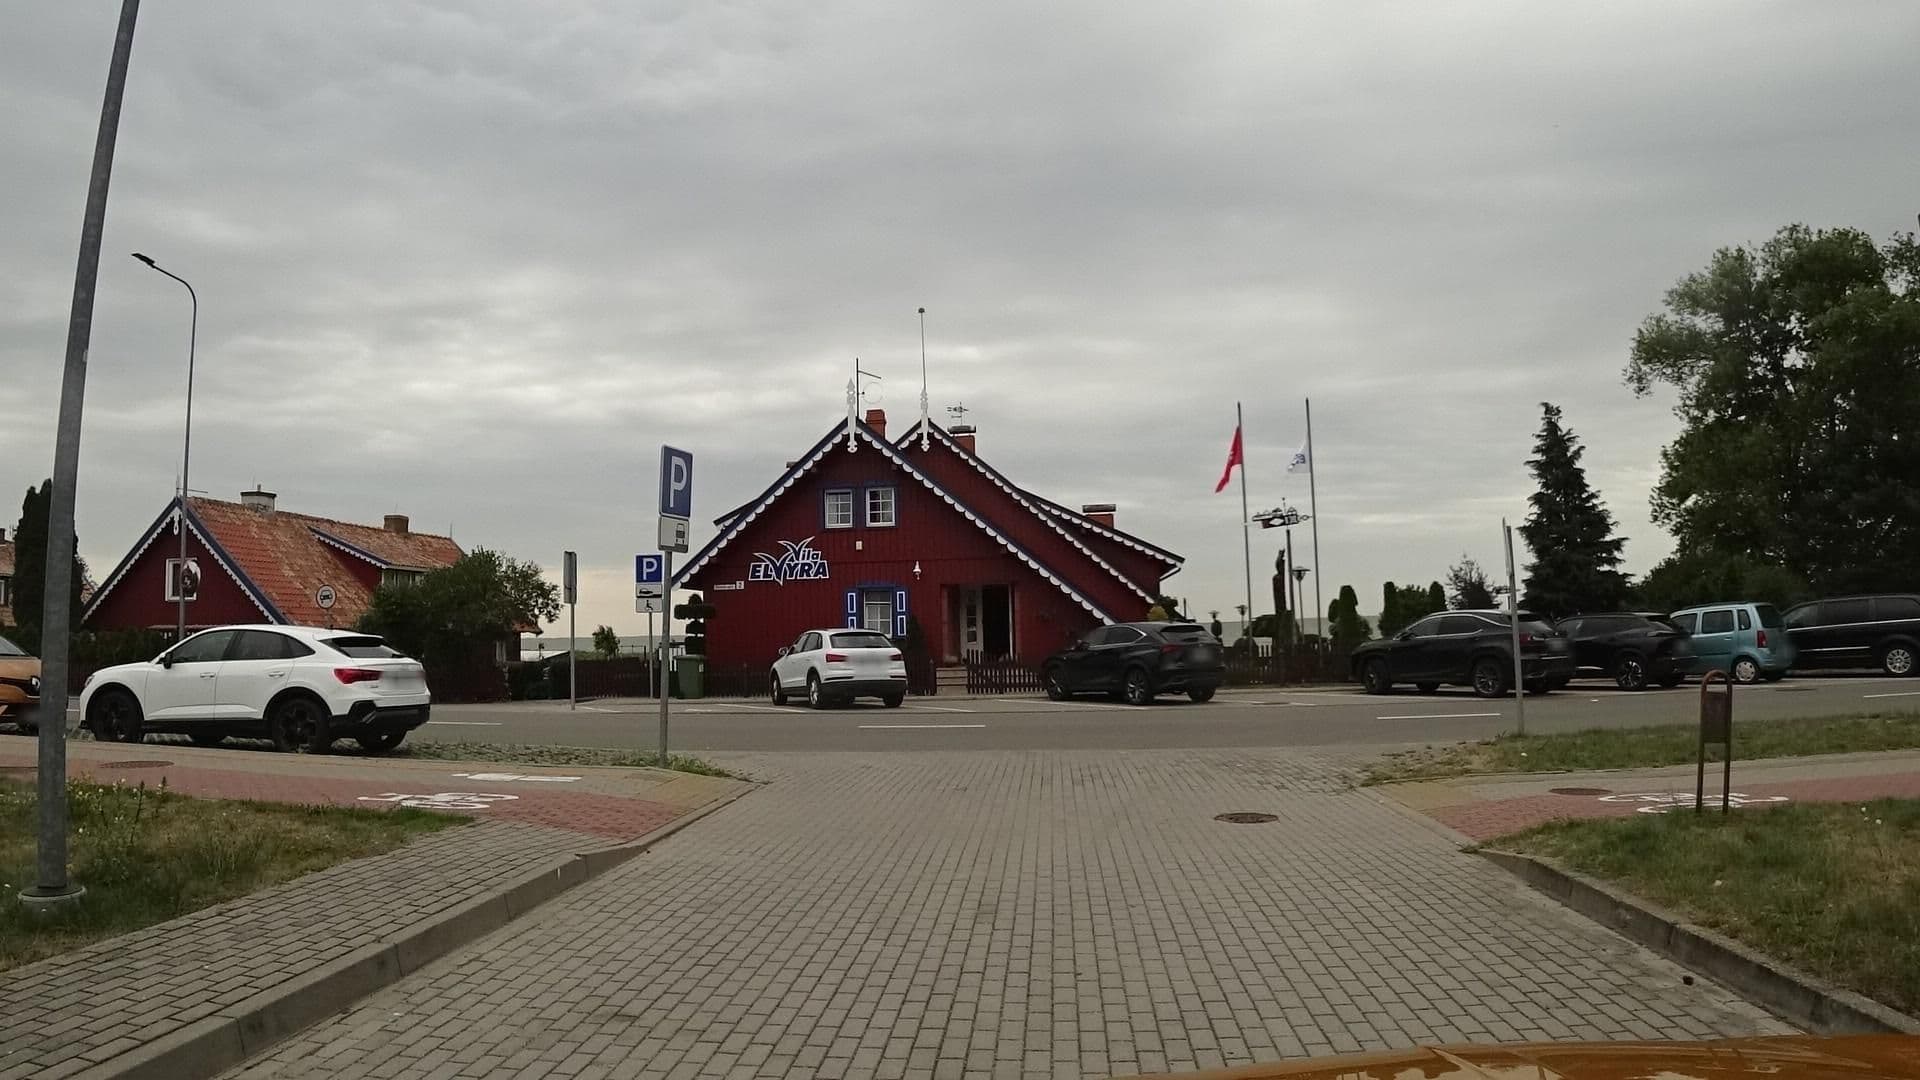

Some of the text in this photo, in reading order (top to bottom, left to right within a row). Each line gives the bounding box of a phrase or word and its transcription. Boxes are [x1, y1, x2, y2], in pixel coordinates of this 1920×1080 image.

[669, 455, 688, 508] P
[777, 536, 822, 562] Vila
[642, 557, 658, 581] P
[749, 552, 830, 586] ELVYRA
